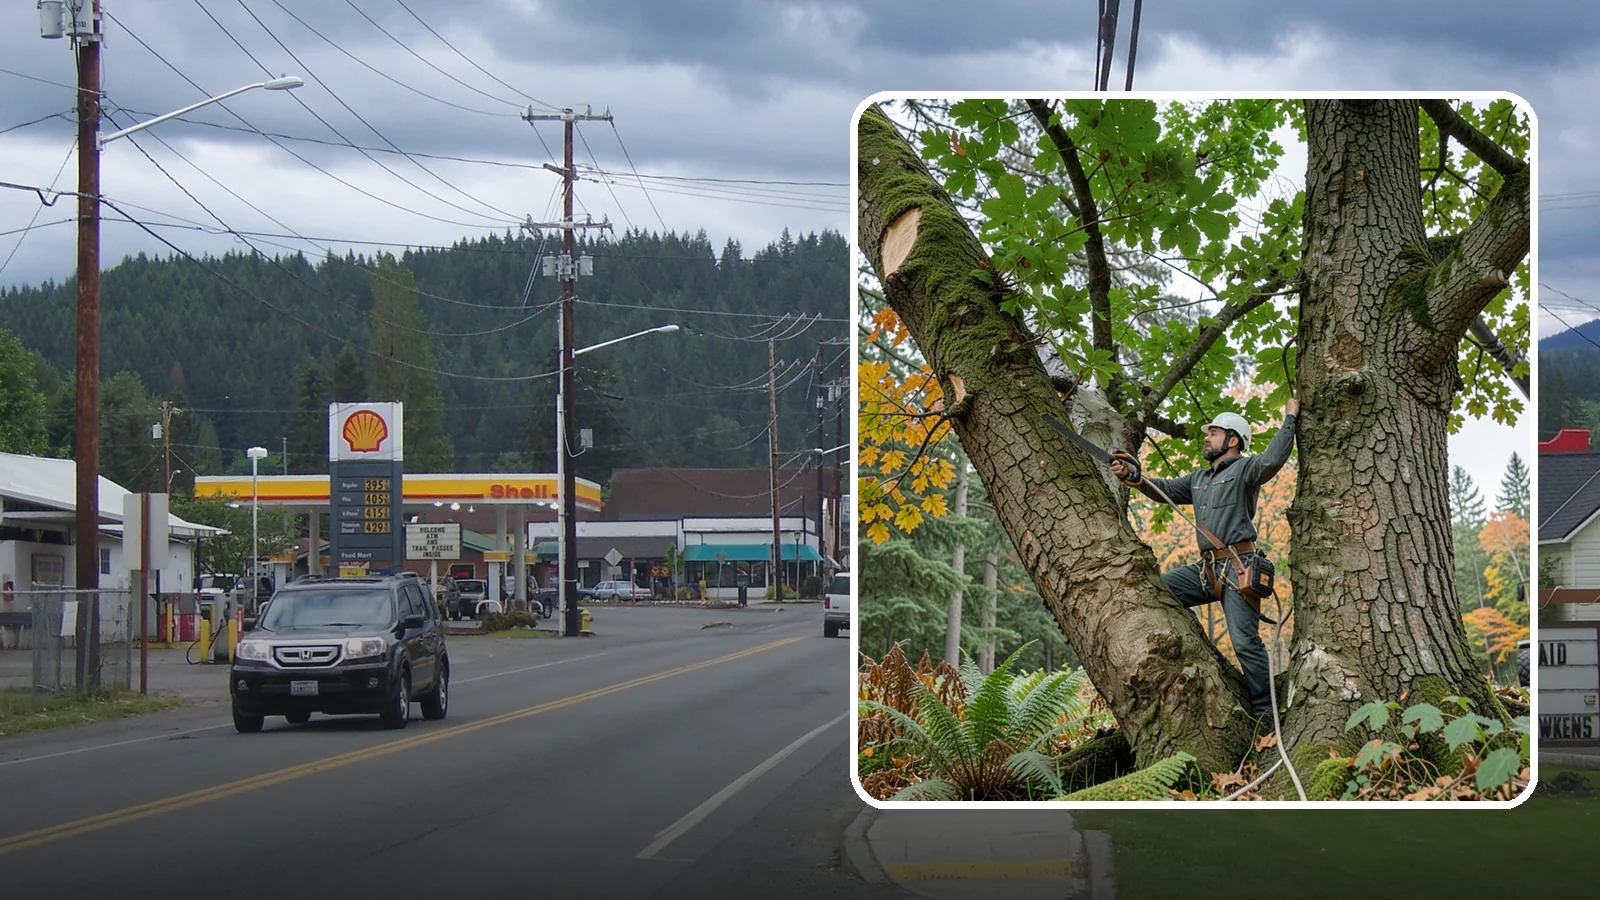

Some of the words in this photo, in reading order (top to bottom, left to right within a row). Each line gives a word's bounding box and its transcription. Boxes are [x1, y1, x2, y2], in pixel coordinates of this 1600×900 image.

[365, 480, 383, 490] 395
[490, 484, 547, 499] Shell
[365, 494, 383, 504] 405
[365, 508, 383, 518] 415
[365, 522, 383, 532] 429
[1538, 643, 1566, 666] AID
